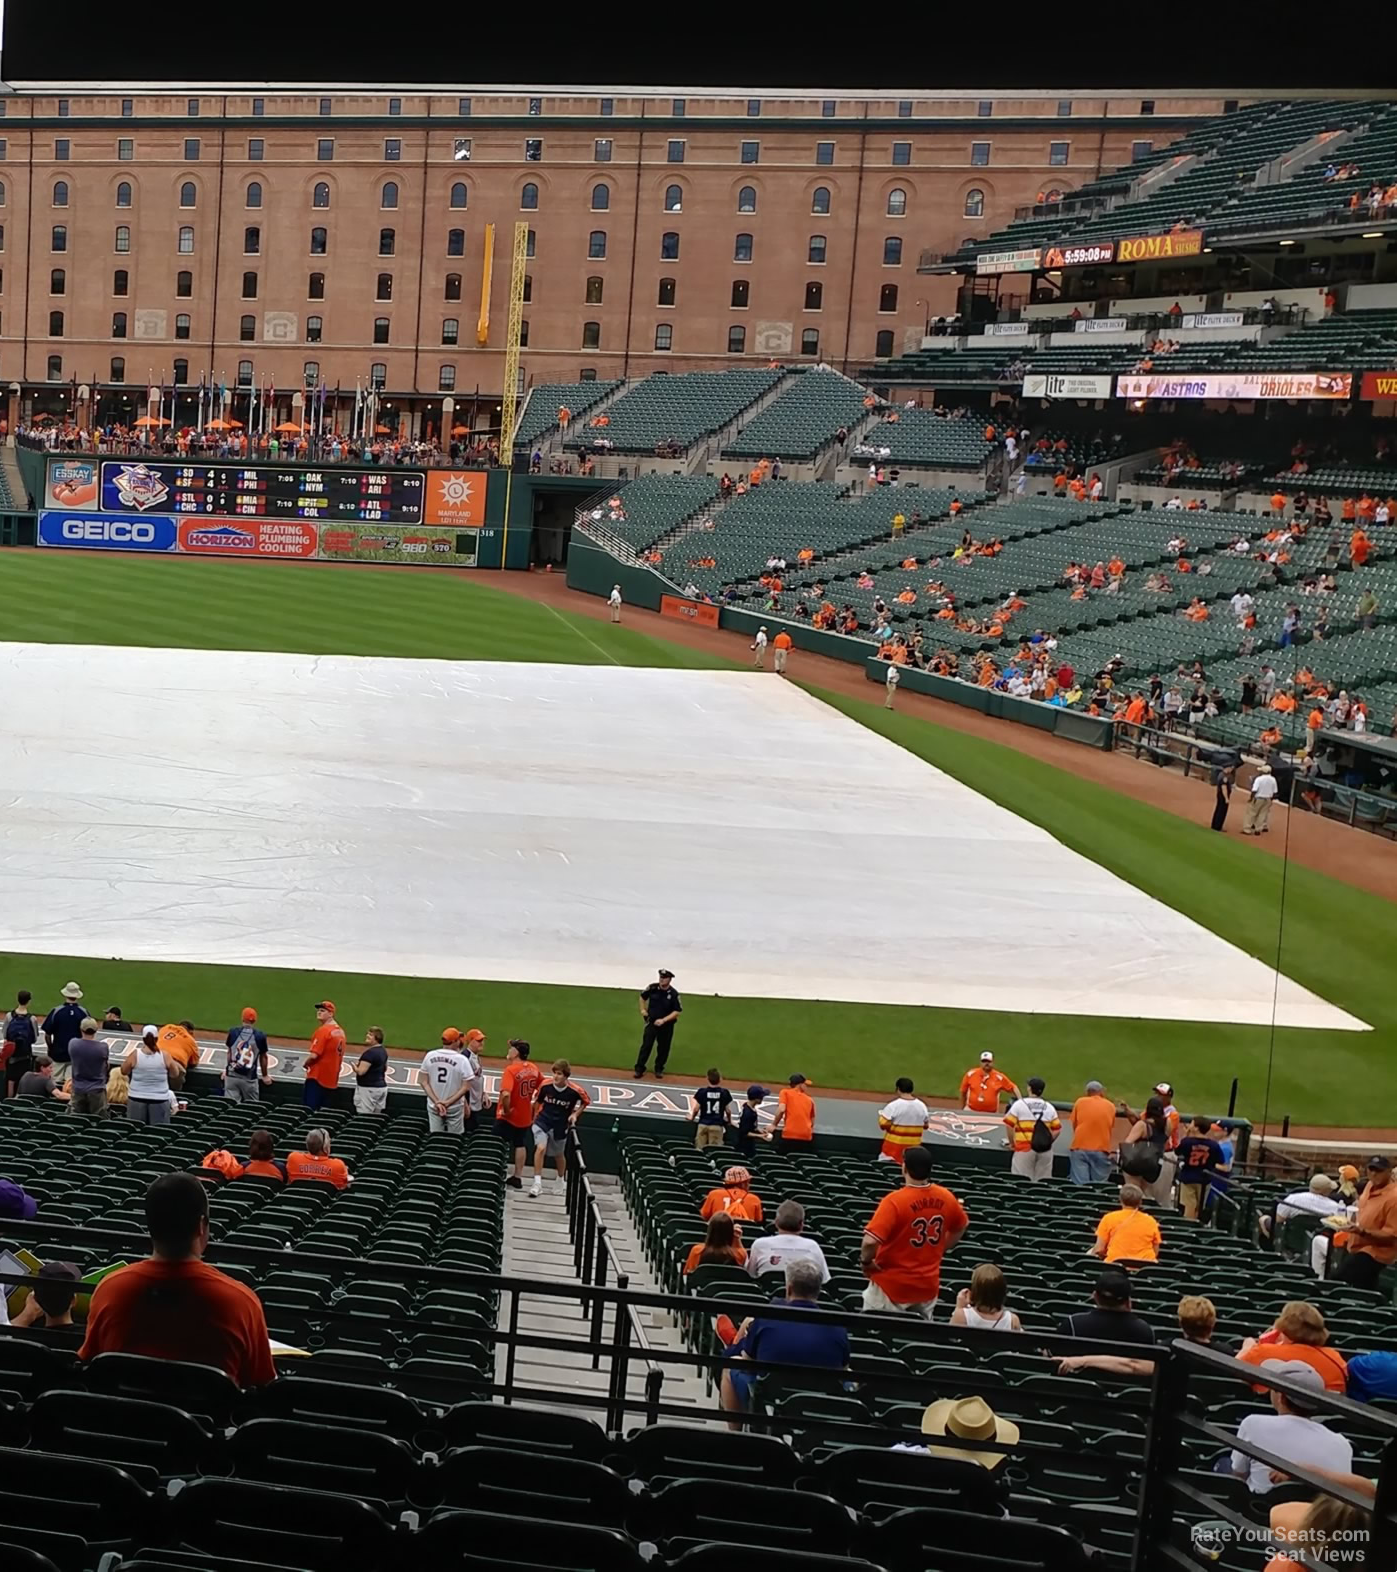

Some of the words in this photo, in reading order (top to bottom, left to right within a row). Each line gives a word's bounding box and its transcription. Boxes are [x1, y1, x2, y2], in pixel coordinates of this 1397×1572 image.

[1119, 236, 1173, 260] ROMA
[1064, 247, 1100, 264] 5:59:08
[1161, 382, 1207, 397] ASTROS
[1260, 382, 1313, 397] ORIOLES
[55, 468, 90, 479] ESSKAY
[183, 468, 194, 477] SD
[207, 470, 215, 478] 4
[244, 471, 258, 480] MIL
[306, 473, 322, 482] OAK
[183, 478, 192, 487] SF
[207, 479, 215, 488] 4
[244, 480, 257, 489] PHI
[368, 475, 387, 485] WAS
[305, 482, 323, 492] NYM
[367, 485, 382, 494] ARI
[182, 493, 195, 502] STL
[206, 494, 213, 503] 0
[242, 498, 258, 506] MIA
[181, 502, 197, 511] CHC
[206, 503, 213, 512] 0
[242, 505, 257, 514] CIN
[366, 500, 381, 510] ATL
[304, 508, 319, 517] COL
[365, 510, 381, 519] LAD
[437, 509, 471, 518] MARYLAND
[62, 519, 155, 543] GEICO
[259, 524, 303, 535] HEATING
[480, 529, 494, 537] 318
[189, 534, 254, 547] HORIZON
[259, 534, 310, 545] PLUMBING
[259, 543, 303, 554] COOLING
[402, 543, 428, 553] 980
[433, 544, 450, 552] 570
[437, 1067, 448, 1084] 2
[706, 1100, 720, 1114] 14
[909, 1214, 945, 1249] 33
